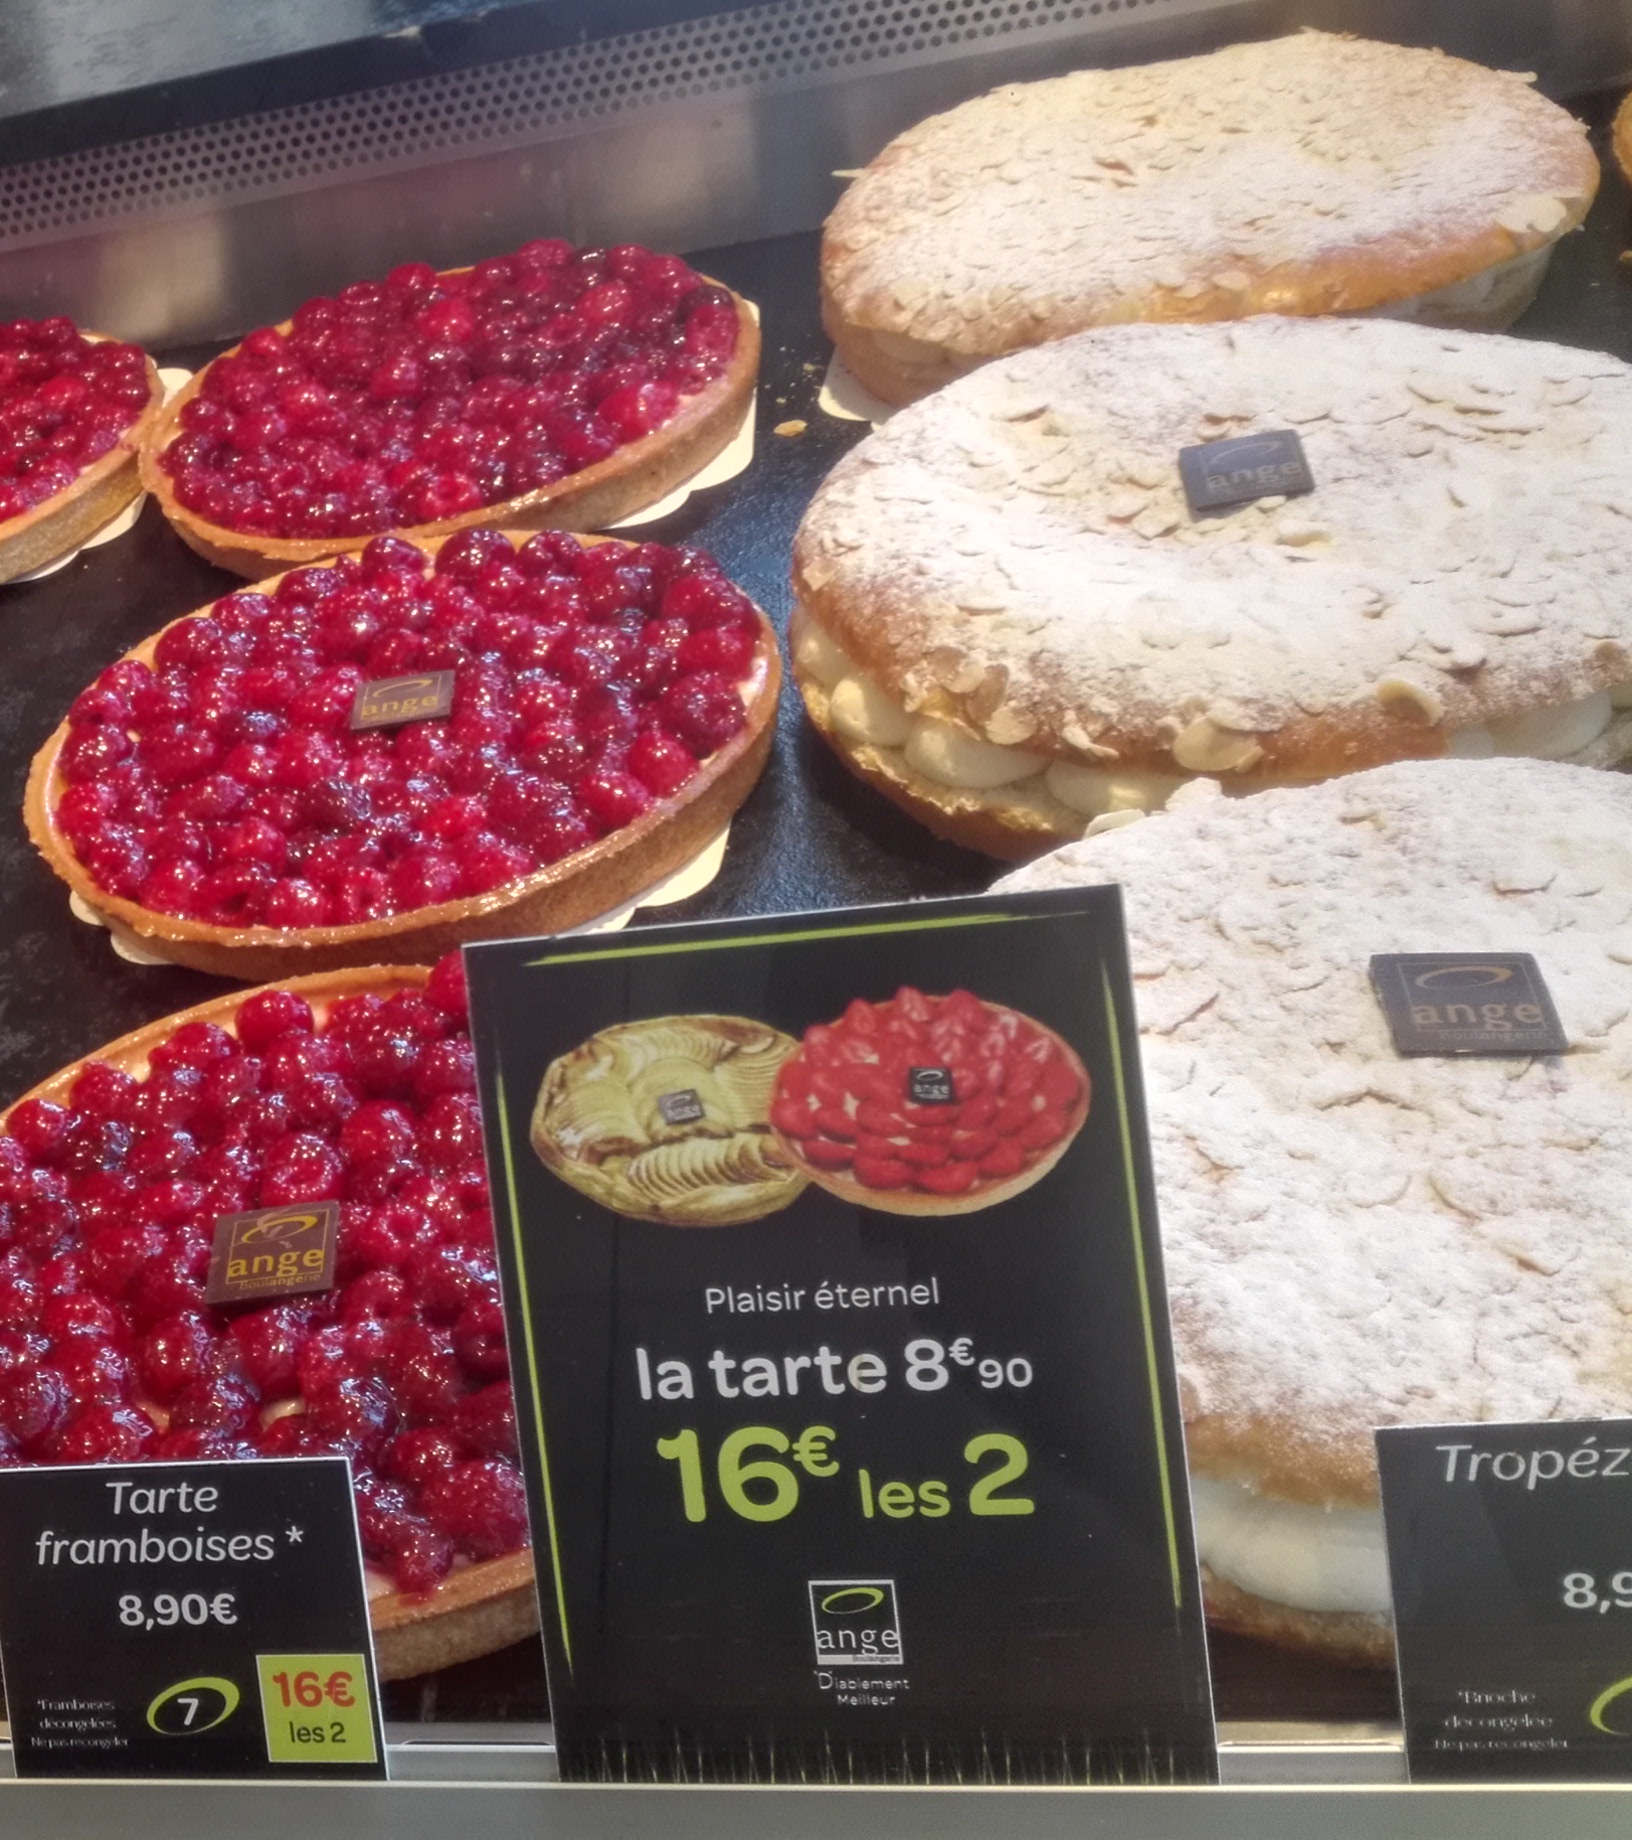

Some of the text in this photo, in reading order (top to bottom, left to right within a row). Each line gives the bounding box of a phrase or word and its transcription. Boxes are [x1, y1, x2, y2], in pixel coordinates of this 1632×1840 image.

[361, 696, 439, 718] ange
[1412, 1002, 1545, 1031] ange
[227, 1249, 325, 1277] ange
[706, 1277, 939, 1314] Plaisir éternel
[636, 1347, 694, 1400] la
[708, 1346, 887, 1398] tarte
[656, 1425, 1035, 1523] 16€ les 2
[105, 1481, 219, 1515] Tarte
[35, 1527, 275, 1565] framboises
[118, 1592, 238, 1631] 8,90€
[816, 1629, 900, 1655] ange
[272, 1671, 356, 1707] 16€
[178, 1697, 199, 1726] 7
[289, 1721, 346, 1743] les 2
